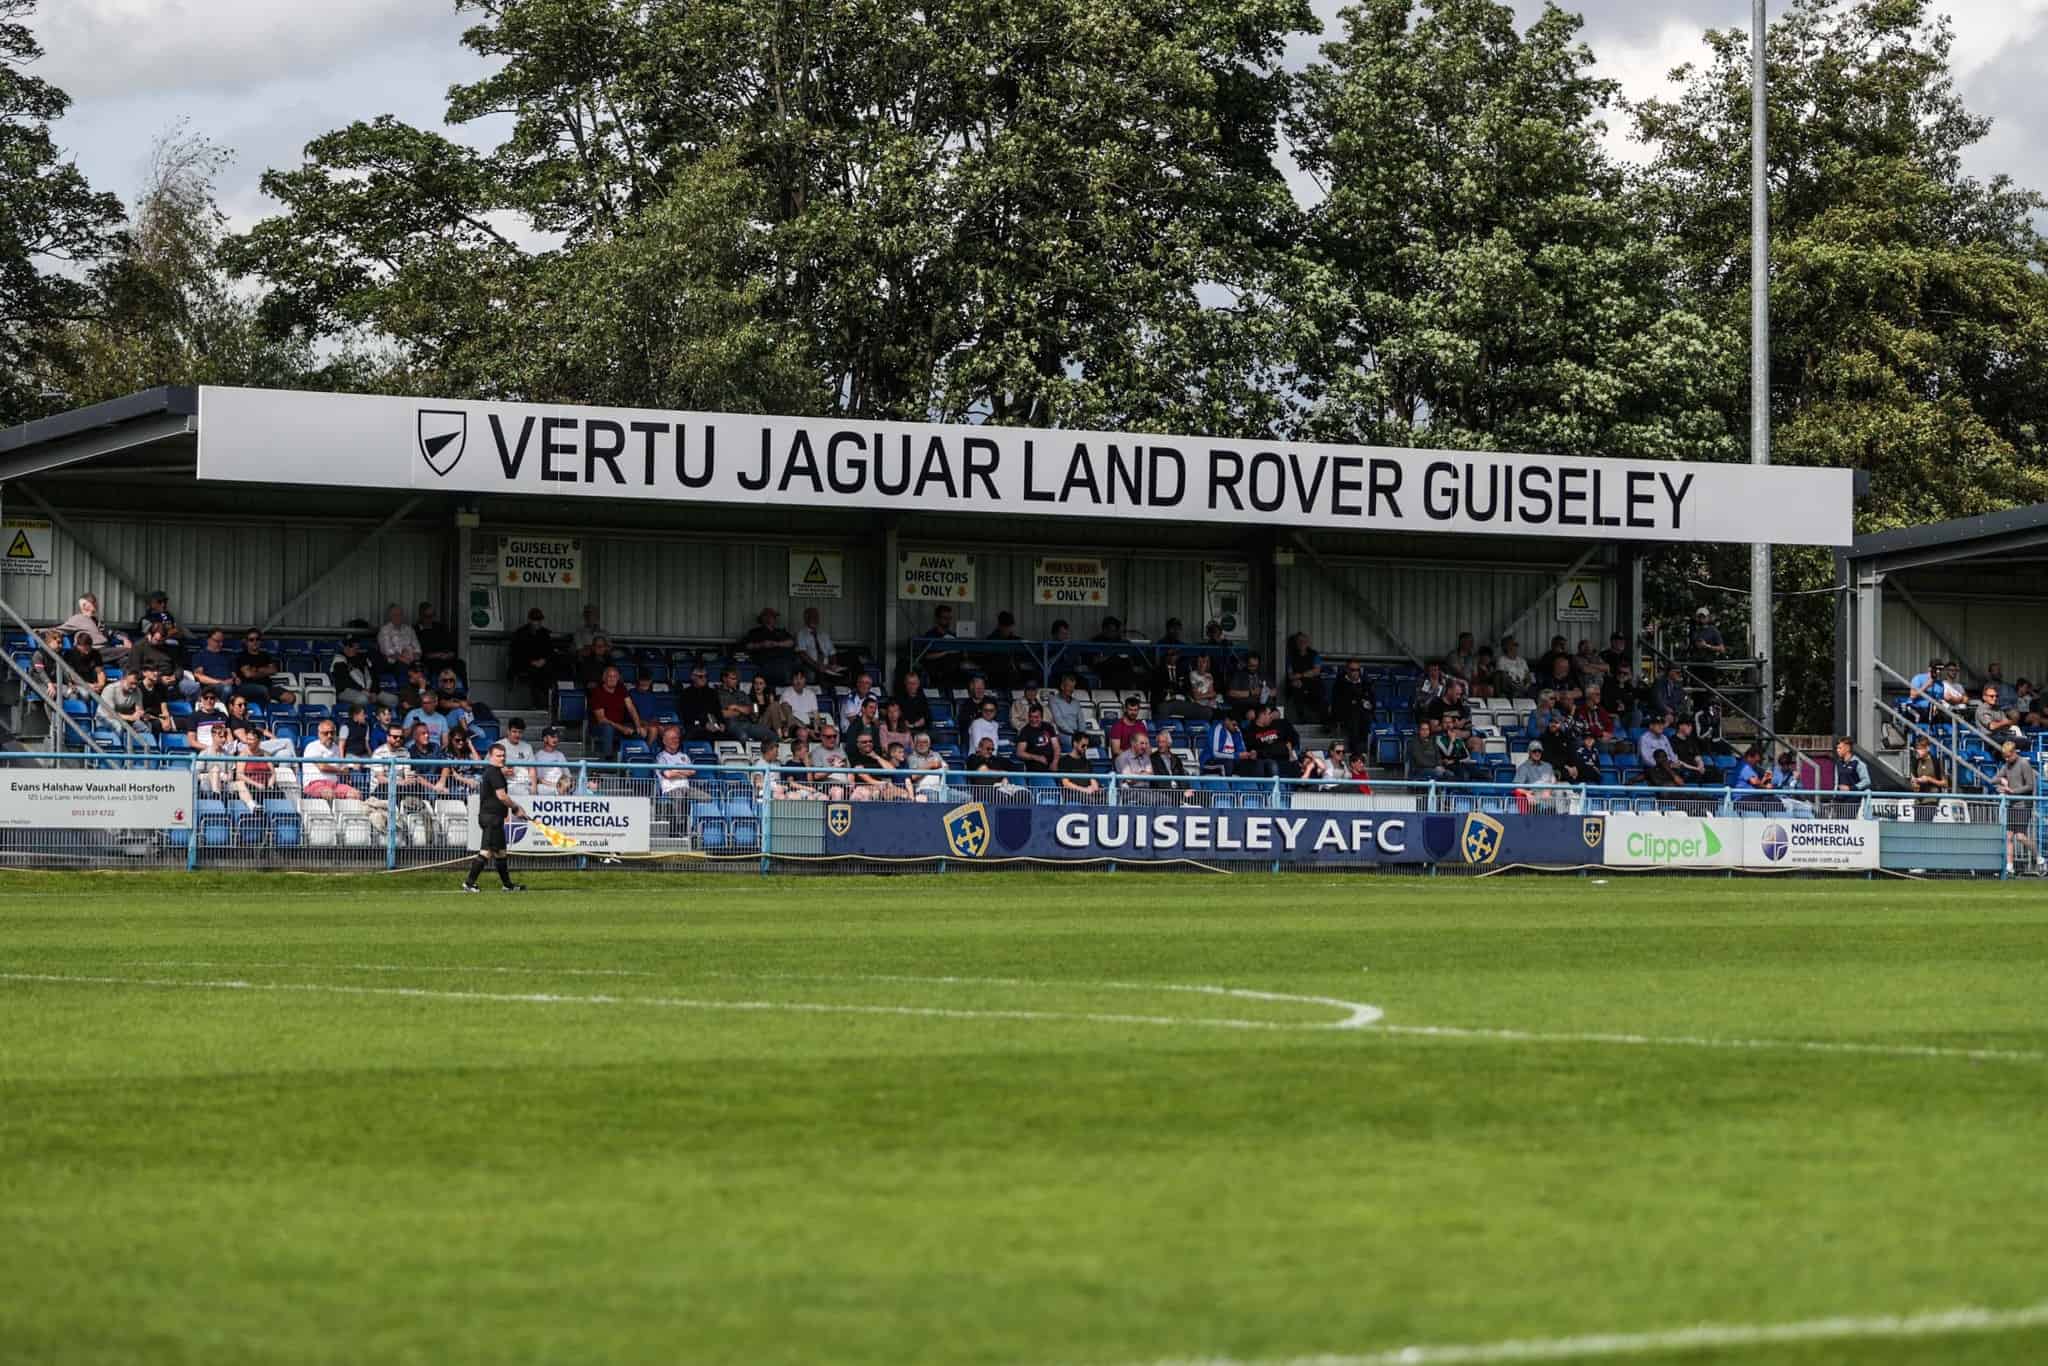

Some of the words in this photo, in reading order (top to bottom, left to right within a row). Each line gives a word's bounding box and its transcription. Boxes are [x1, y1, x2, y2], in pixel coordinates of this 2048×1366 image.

[487, 413, 715, 489] VERTU
[737, 427, 1001, 500] JAGUAR
[1023, 440, 1186, 507] LAND
[1208, 449, 1403, 518] ROVER
[1423, 460, 1695, 529] GUISELEY
[511, 541, 570, 554] GUISELEY
[505, 556, 574, 570] DIRECTORS
[920, 556, 954, 569] AWAY
[522, 571, 557, 584] ONLY
[905, 570, 969, 584] DIRECTORS
[1037, 575, 1065, 587] PRESS
[1067, 576, 1106, 589] SEATING
[921, 584, 953, 597] ONLY
[1056, 590, 1087, 601] ONLY
[10, 782, 40, 792] Evans
[42, 782, 83, 792] Halshaw
[85, 783, 127, 792] Vauxhall
[128, 783, 175, 793] Horsforth
[532, 800, 610, 814] NORTHERN
[532, 814, 630, 828] COMMERCIALS
[1056, 812, 1309, 851] GUISELEY
[1314, 819, 1406, 855] AFC
[1791, 823, 1849, 834] NORTHERN
[1626, 831, 1702, 862] Clipper
[1791, 835, 1865, 847] COMMERCIALS
